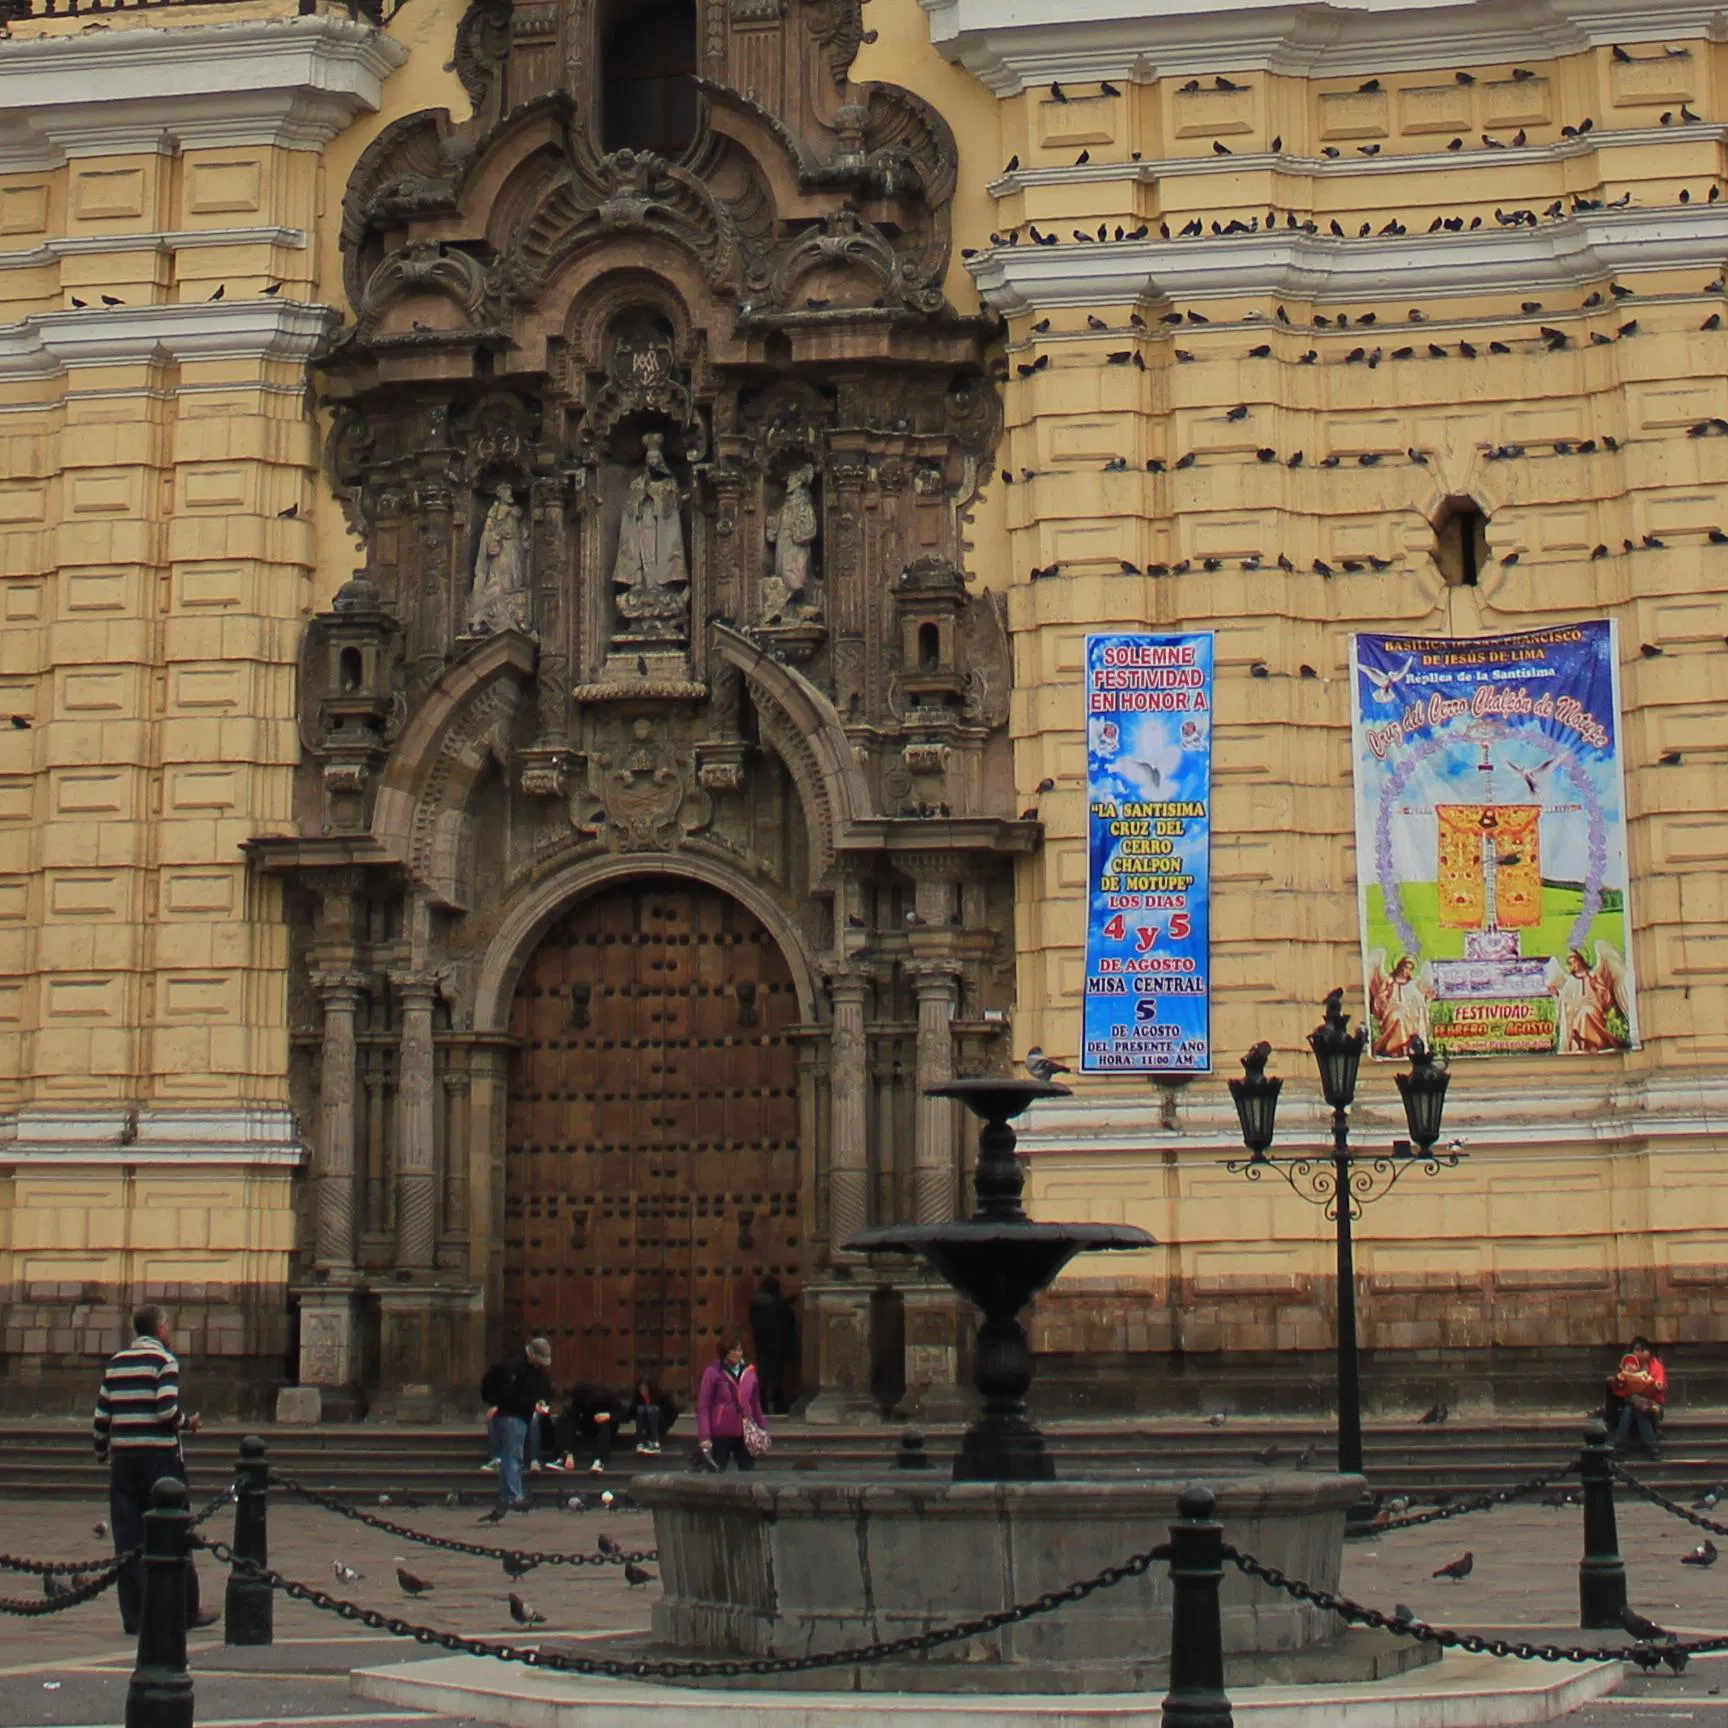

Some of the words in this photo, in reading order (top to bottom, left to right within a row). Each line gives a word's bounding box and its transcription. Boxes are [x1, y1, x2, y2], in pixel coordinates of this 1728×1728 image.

[1104, 646, 1195, 666] SOLEMNE
[1423, 655, 1440, 665] DE
[1489, 652, 1508, 663] DE
[1512, 649, 1545, 661] LIMA
[1094, 669, 1205, 689] FESTIVIDAD
[1457, 672, 1472, 682] de
[1476, 671, 1488, 681] la
[1090, 693, 1116, 711] EN
[1120, 692, 1188, 711] HONOR
[1193, 692, 1208, 710] A
[1367, 723, 1403, 760] Cruz
[1403, 699, 1425, 732] del
[1428, 692, 1468, 726] Cerro
[1534, 692, 1554, 717] de
[1555, 695, 1608, 748] Motupe
[1123, 802, 1205, 817] SANTISIMA
[1110, 821, 1150, 836] CRUZ
[1156, 821, 1185, 835] DEL
[1122, 840, 1173, 855] CERRO
[1112, 858, 1182, 873] CHALPON
[1101, 876, 1121, 892] DE
[1110, 895, 1140, 909] LOS
[1145, 895, 1186, 909] DIAS
[1104, 913, 1126, 940] 4
[1136, 927, 1160, 953] y
[1169, 913, 1191, 939] 5
[1100, 958, 1121, 972] DE
[1126, 958, 1195, 972] AGOSTO
[1088, 977, 1126, 993] MISA
[1134, 977, 1204, 993] CENTRAL
[1135, 999, 1156, 1021] 5
[1455, 1005, 1535, 1021] FESTIVIDAD:
[1112, 1026, 1127, 1037] DE
[1134, 1026, 1180, 1037] AGOSTO
[1505, 1021, 1553, 1036] AGOSTO
[1088, 1042, 1108, 1052] DEL
[1115, 1041, 1173, 1052] PRESENTE
[1142, 1055, 1169, 1065] 11:00
[1175, 1055, 1193, 1065] AM
